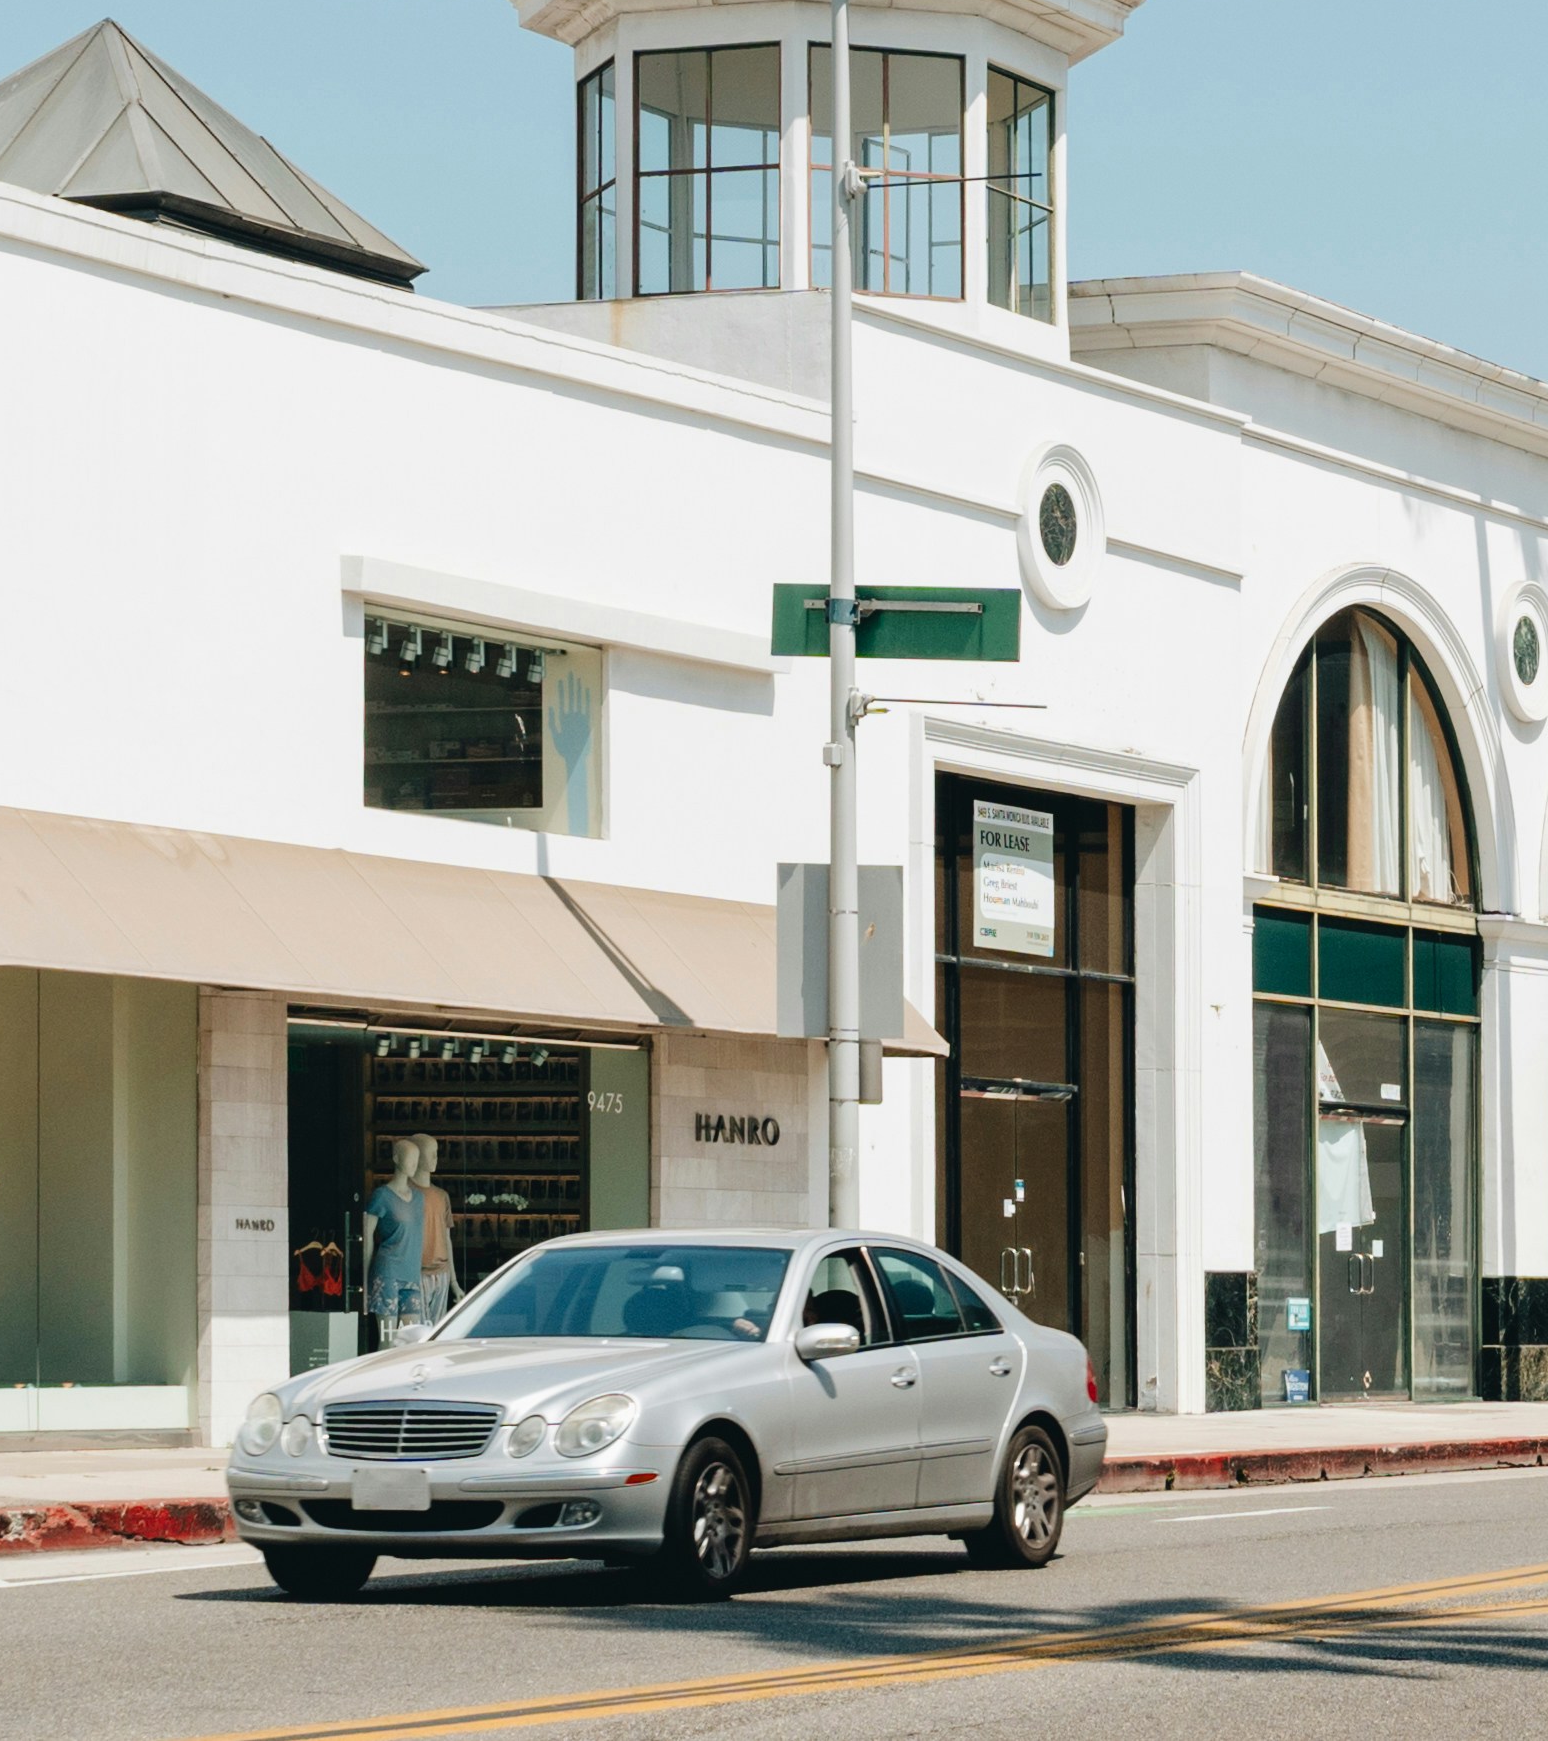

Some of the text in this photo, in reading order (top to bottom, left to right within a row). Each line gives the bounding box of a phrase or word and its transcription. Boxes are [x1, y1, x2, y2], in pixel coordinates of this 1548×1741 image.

[980, 829, 1030, 852] FOR LEASE
[983, 877, 1017, 891] Greg Briest
[983, 893, 1010, 905] Houman
[587, 1091, 623, 1114] 9475
[695, 1112, 780, 1146] HANRO
[236, 1218, 275, 1232] HANRO
